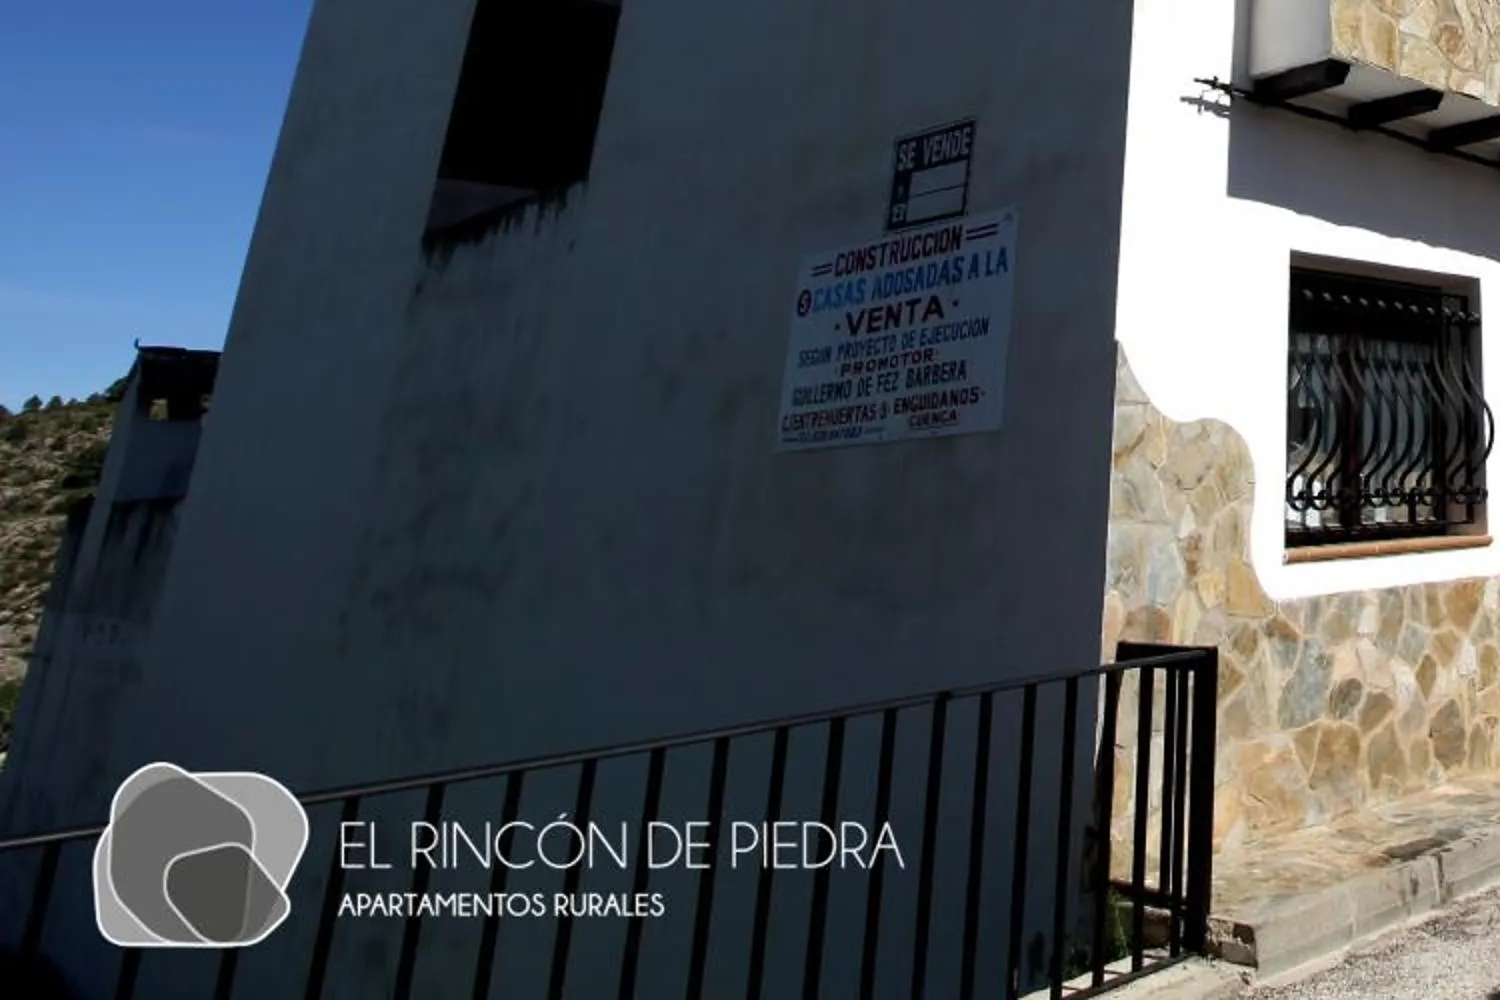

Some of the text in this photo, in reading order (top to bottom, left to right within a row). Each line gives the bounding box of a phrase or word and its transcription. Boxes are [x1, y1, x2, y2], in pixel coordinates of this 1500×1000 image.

[898, 126, 972, 170] SE VENDE
[834, 224, 963, 277] CONSTRUCCION
[813, 278, 867, 313] CASAS
[871, 255, 966, 301] ADOSADAS
[967, 252, 980, 281] A
[986, 246, 1009, 276] LA
[845, 295, 945, 336] VENTA
[837, 333, 897, 362] PROYECTO
[901, 329, 916, 349] DE
[920, 316, 990, 347] EJECUCION
[840, 347, 935, 377] PROMOTOR
[792, 359, 967, 407] GUILLERMO DE FEZ BARBERA
